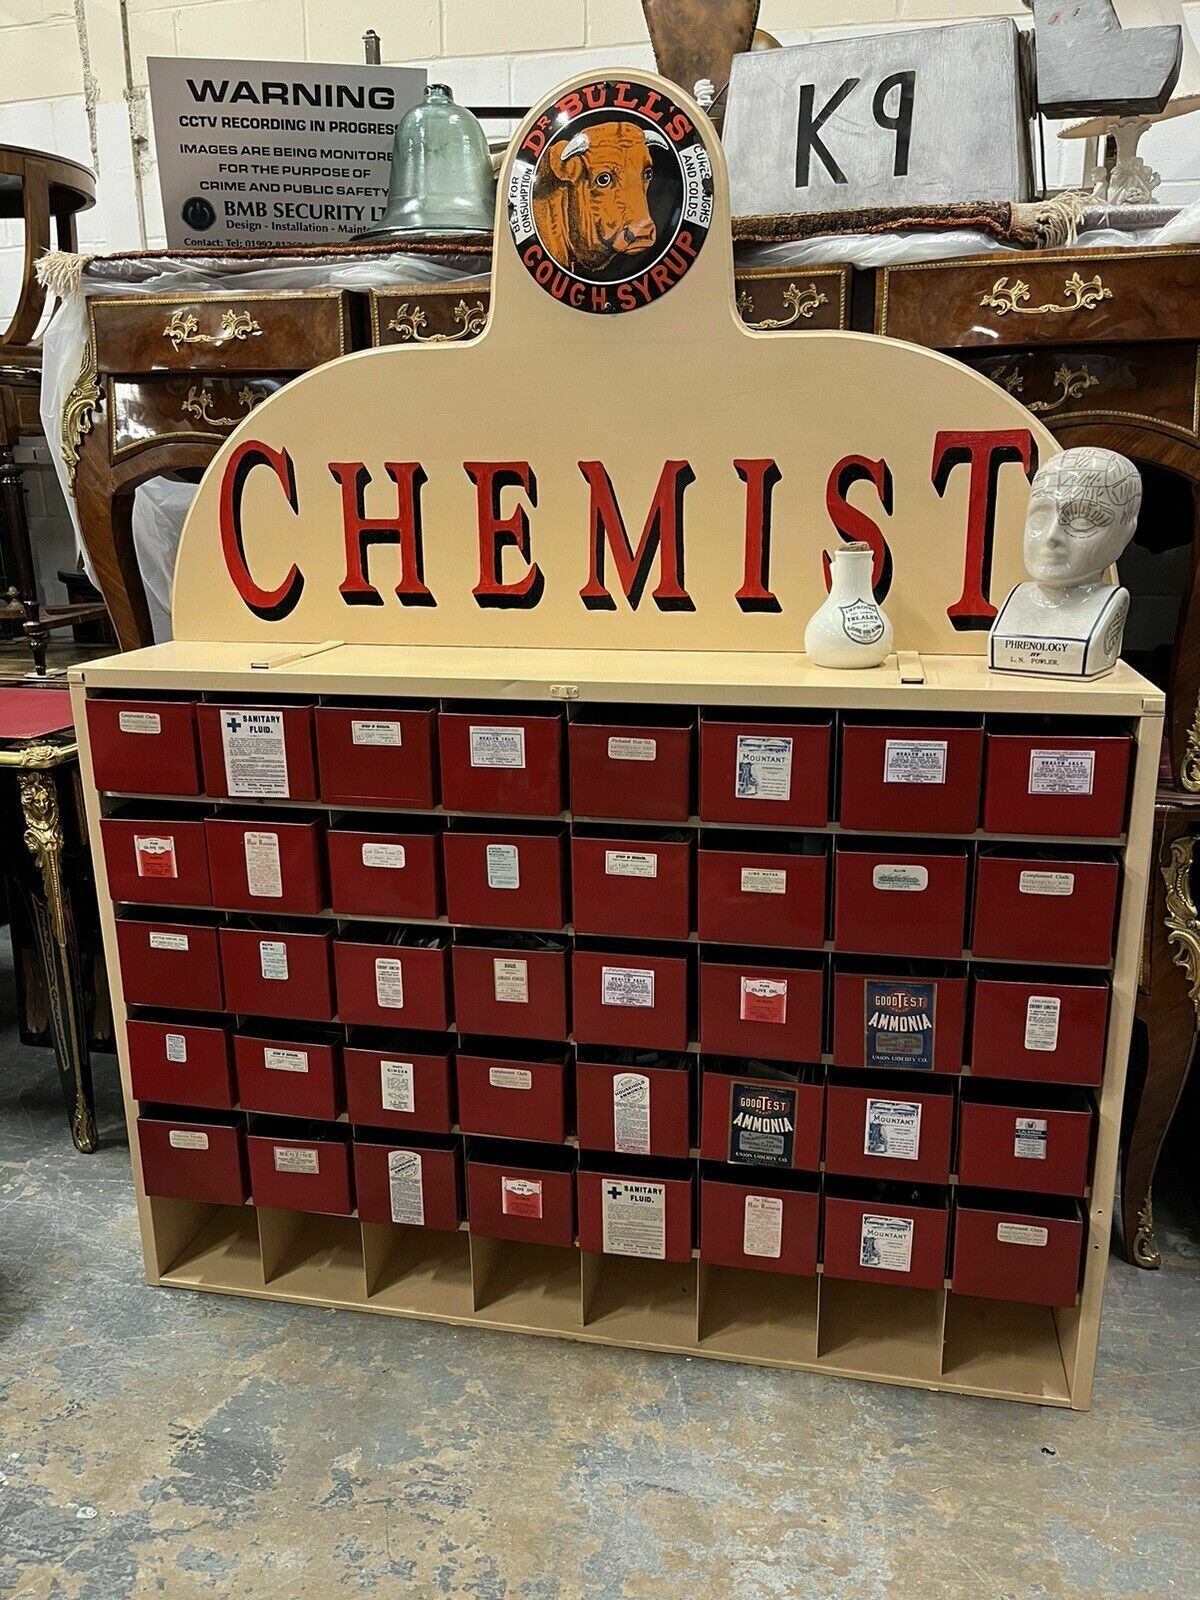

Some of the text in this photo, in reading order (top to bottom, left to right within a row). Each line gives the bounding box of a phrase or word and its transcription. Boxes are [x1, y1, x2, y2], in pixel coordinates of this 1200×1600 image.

[186, 79, 395, 110] WARNING
[555, 84, 692, 141] BULL'S
[179, 115, 217, 128] CCTV
[222, 117, 306, 131] RECORDING
[310, 120, 325, 132] IN
[180, 144, 393, 162] IMAGES ARE BEING MONITORE
[219, 163, 371, 179] FOR THE PURPOSE OF
[200, 181, 390, 197] CRIME AND PUBLIC SAFETY
[510, 176, 519, 198] FOR
[682, 155, 699, 219] AND COLDS.
[520, 168, 533, 233] CONSUMPTION
[224, 200, 387, 222] BMB SECURITY LT
[226, 220, 262, 233] Design
[271, 221, 329, 234] Installation
[184, 238, 223, 248] Contact:
[226, 239, 243, 248] Tel:
[523, 231, 697, 310] COUGH SYRUP
[219, 429, 1040, 632] CHEMIST
[1005, 640, 1069, 652] PHRENOLOGY
[243, 715, 280, 723] SANITARY
[250, 726, 273, 734] FLUID.
[868, 1012, 933, 1032] AMMONIA
[733, 1112, 794, 1133] AMMONIA
[624, 1185, 663, 1195] SANITARY
[630, 1195, 655, 1204] FLUID.
